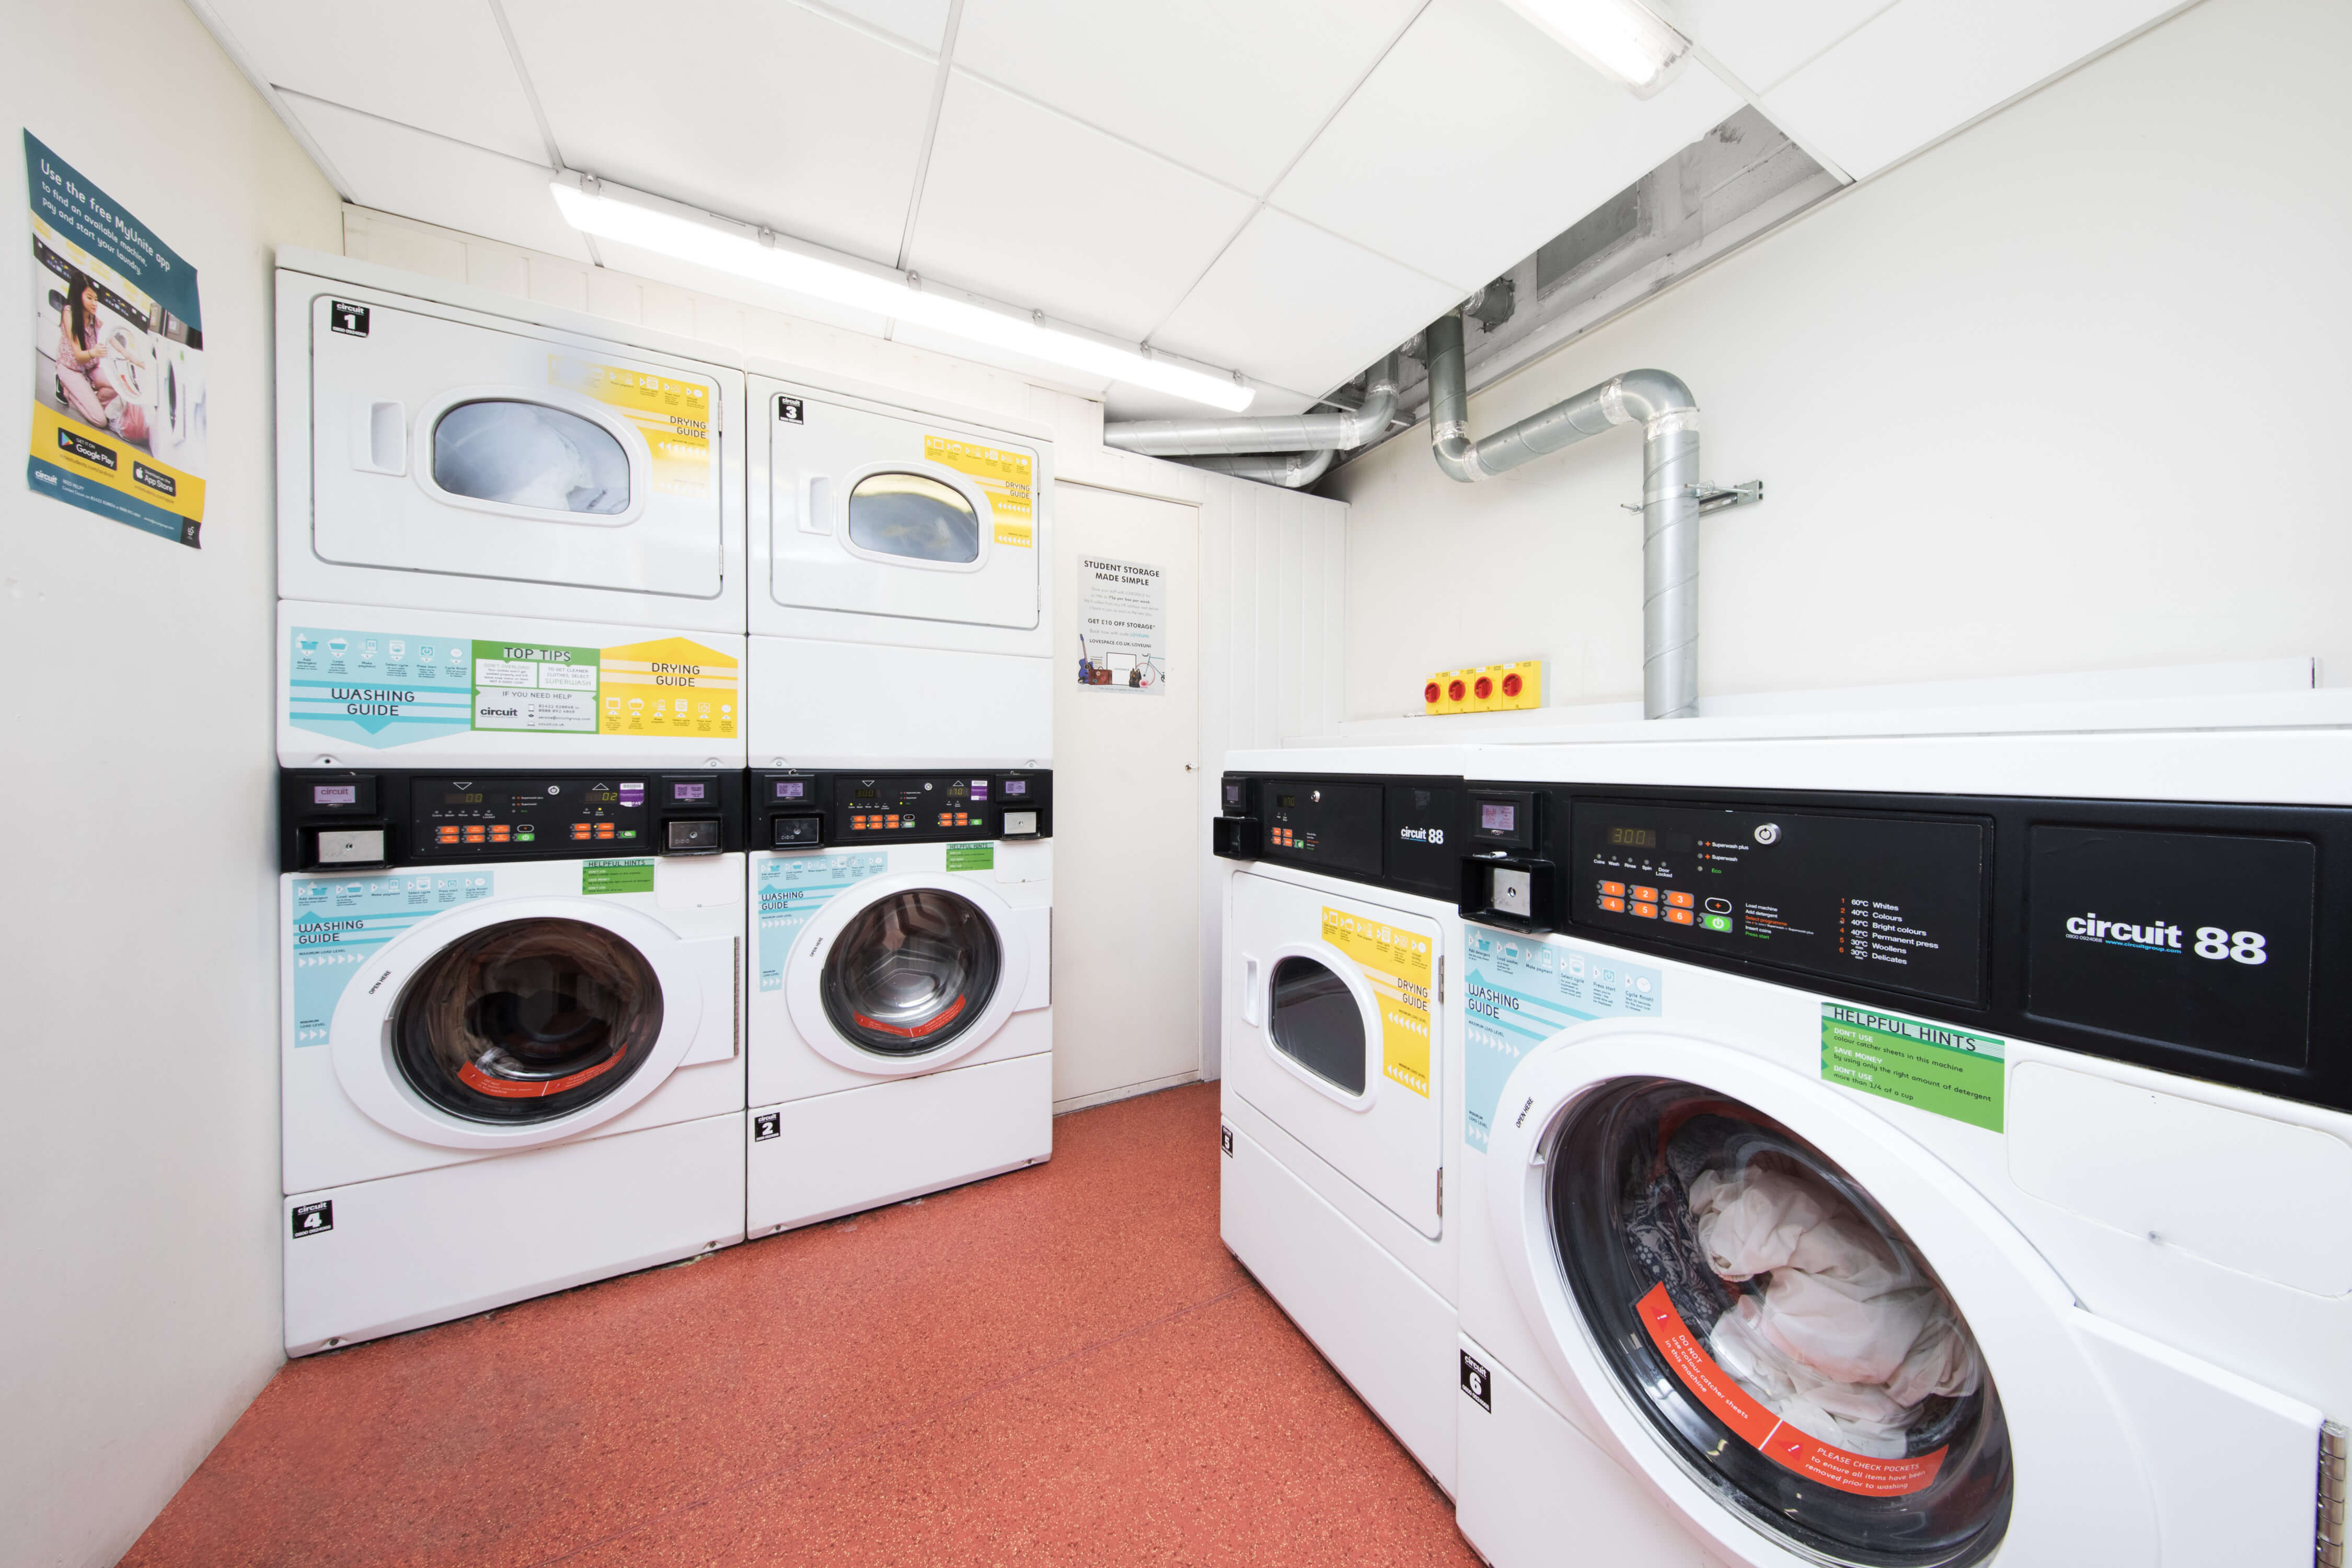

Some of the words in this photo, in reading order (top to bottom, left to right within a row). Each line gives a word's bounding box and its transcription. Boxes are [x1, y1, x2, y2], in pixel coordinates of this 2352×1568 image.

[40, 159, 62, 186] Use
[66, 180, 86, 203] the
[89, 197, 112, 223] free
[115, 216, 154, 256] MyUnite
[155, 254, 170, 272] app
[41, 181, 51, 193] to
[53, 189, 68, 207] find
[71, 204, 82, 217] an
[84, 213, 119, 244] available
[120, 240, 147, 267] machine,
[42, 197, 56, 215] pay
[59, 209, 74, 225] and
[76, 221, 95, 240] start
[97, 238, 115, 254] your
[117, 249, 142, 275] laundry.
[344, 314, 355, 329] 1
[786, 406, 797, 419] 3
[670, 416, 706, 429] DRYING
[677, 427, 706, 439] GUIDE
[76, 444, 100, 459] Google
[101, 454, 114, 467] Play
[144, 475, 156, 486] App
[157, 480, 173, 492] Store
[1006, 481, 1030, 491] DRYING
[1010, 490, 1030, 499] GUIDE
[1084, 560, 1122, 572] STUDENT
[1124, 567, 1160, 577] STORAGE
[1096, 572, 1119, 582] MADE
[1122, 576, 1149, 586] SIMPLE
[1089, 639, 1151, 648] LOVESPACE.CO.UK/LOVEUNI
[504, 648, 534, 659] TOP
[539, 650, 571, 662] TIPS
[652, 662, 700, 675] DRYING
[656, 676, 696, 687] GUIDE
[331, 688, 415, 702] WASHING
[347, 704, 399, 716] GUIDE
[480, 707, 518, 716] circuit
[1401, 826, 1426, 839] circuit
[1428, 828, 1444, 844] 88
[1614, 828, 1645, 845] 300
[762, 891, 803, 902] WASHING
[762, 902, 788, 910] GUIDE
[1873, 902, 1899, 911] Whites
[1873, 912, 1903, 922] Colours
[299, 920, 364, 932] WASHING
[1873, 923, 1895, 931] Bright
[1897, 927, 1927, 936] colours
[299, 933, 340, 944] GUIDE
[1872, 932, 1915, 945] Permanent
[1916, 940, 1939, 949] press
[2066, 913, 2183, 948] circuit
[2194, 927, 2267, 965] 88
[2105, 939, 2182, 954] www.circuitgroup.com
[1872, 942, 1907, 954] Woollens
[1872, 953, 1907, 964] Delicates
[369, 982, 382, 994] OPEN
[379, 970, 392, 982] HERE
[1398, 978, 1427, 997] DRYING
[1403, 993, 1427, 1011] GUIDE
[1468, 983, 1519, 1010] WASHING
[1469, 998, 1500, 1019] GUIDE
[1835, 1007, 1911, 1036] HELPFUL
[1919, 1027, 1976, 1052] HINTS
[1835, 1028, 1856, 1037] DON'T
[1859, 1034, 1873, 1042] USE
[1834, 1035, 1855, 1044] colour
[1857, 1041, 1881, 1051] catcher
[1883, 1048, 1905, 1057] sheets
[1932, 1060, 1963, 1073] machine
[1834, 1046, 1853, 1057] SAVE
[1855, 1052, 1883, 1064] MONEY
[1834, 1065, 1856, 1076] DON'T
[1859, 1072, 1873, 1081] USE
[1844, 1057, 1860, 1066] using
[1863, 1062, 1877, 1071] only
[1912, 1076, 1940, 1087] amount
[1954, 1087, 1991, 1102] detergent
[1516, 1111, 1526, 1128] OPEN
[1523, 1097, 1534, 1113] HERE
[762, 1122, 773, 1136] 2
[304, 1212, 322, 1228] 4
[1679, 1335, 1689, 1346] DO
[1688, 1347, 1702, 1363] NOT
[1465, 1355, 1486, 1378] circuit
[1671, 1349, 1681, 1363] this
[1681, 1364, 1707, 1392] machine
[1470, 1372, 1482, 1396] 6
[1672, 1337, 1681, 1349] use
[1681, 1351, 1701, 1373] colour
[1700, 1375, 1725, 1398] catcher
[1725, 1399, 1748, 1419] sheets
[1817, 1448, 1851, 1465] PLEASE
[1853, 1461, 1881, 1471] CHECK
[1884, 1463, 1919, 1472] POCKETS
[1823, 1462, 1850, 1474] ensure
[1805, 1464, 1841, 1481] removed
[1842, 1478, 1863, 1486] prior
